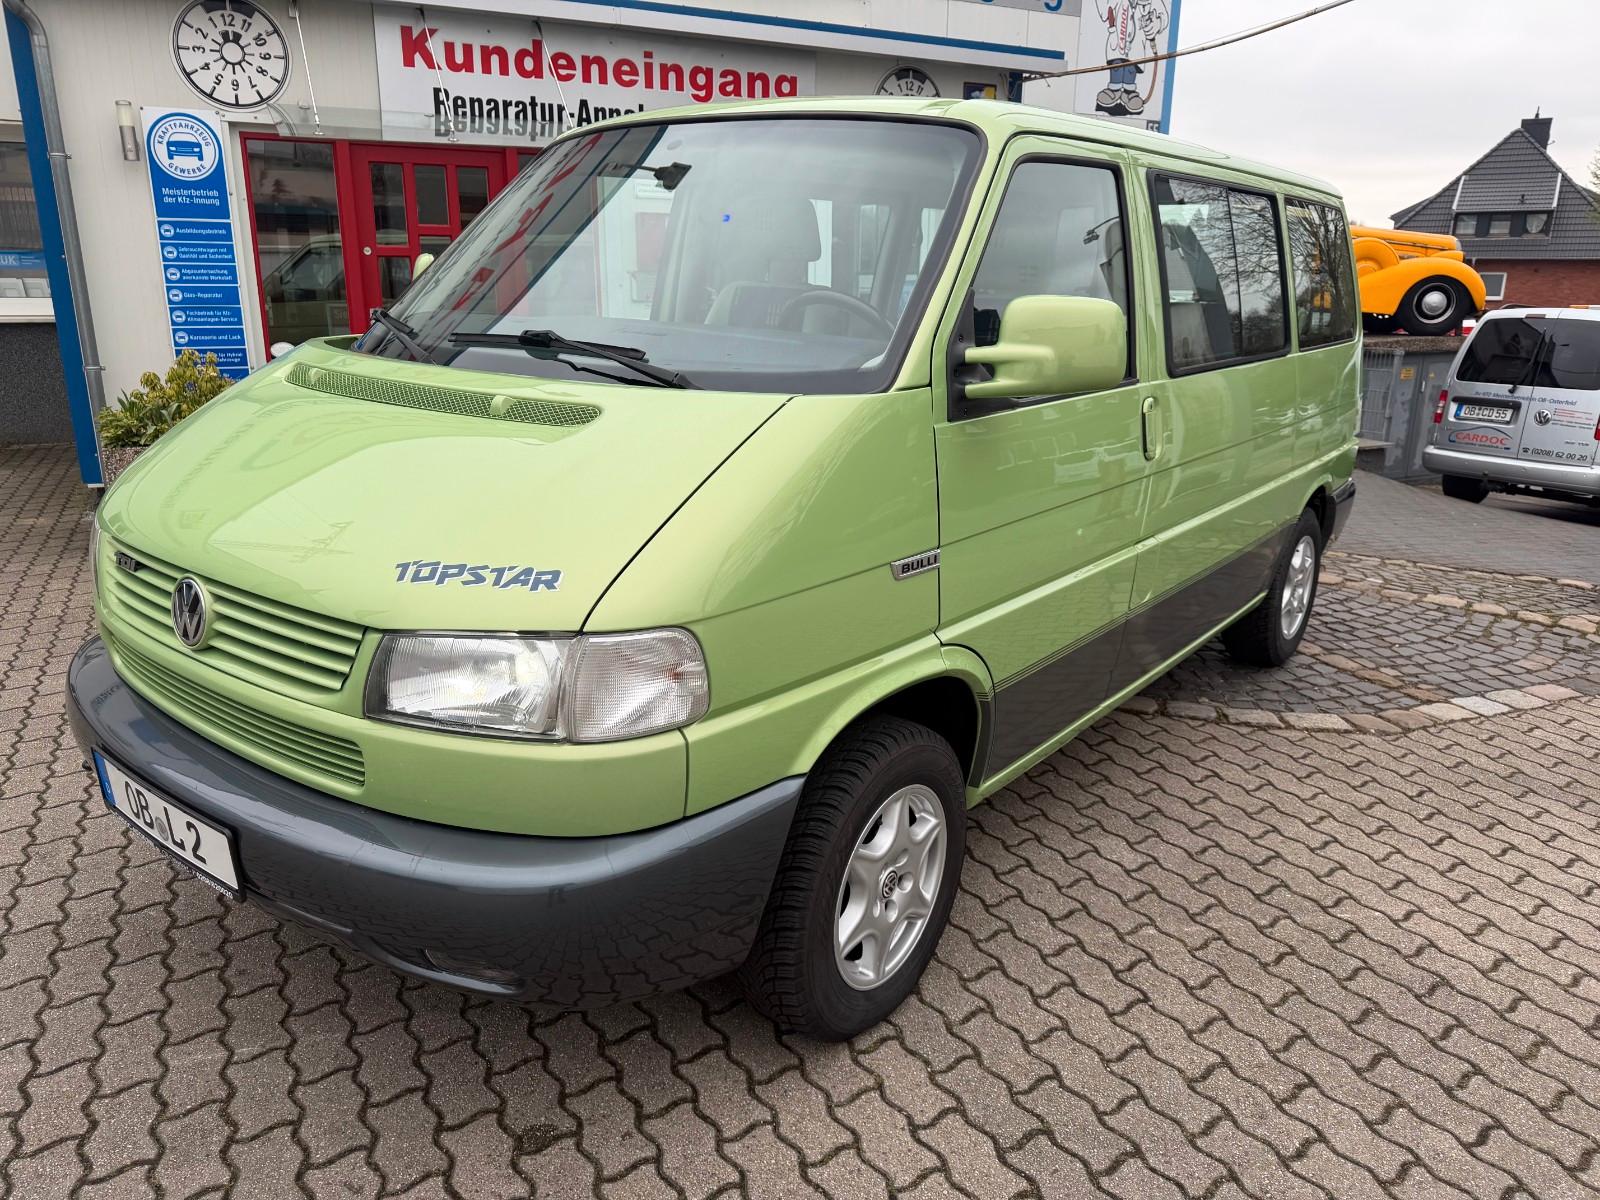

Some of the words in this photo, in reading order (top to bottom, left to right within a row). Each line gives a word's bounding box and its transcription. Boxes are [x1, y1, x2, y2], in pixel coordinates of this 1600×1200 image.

[208, 16, 217, 28] 1
[220, 13, 236, 27] 12
[240, 19, 252, 32] 11
[194, 27, 208, 39] 2
[253, 32, 267, 47] 10
[192, 45, 205, 54] 3
[199, 62, 211, 72] 4
[400, 25, 798, 103] Kundeneingang
[256, 65, 269, 77] 8
[213, 73, 224, 86] 5
[905, 81, 914, 91] 12
[157, 121, 212, 147] KRAFTFAHRZEUG
[168, 162, 207, 175] GEWERBE
[161, 187, 219, 197] Meisterbetrieb
[177, 196, 220, 206] Kfz-Innung
[1464, 406, 1476, 416] OB
[1481, 407, 1495, 418] CD
[1494, 409, 1508, 419] 55
[1455, 431, 1509, 445] CARDOC
[1531, 447, 1554, 457] (0208)
[1566, 452, 1576, 460] 00
[901, 554, 937, 574] BULLI
[395, 559, 563, 592] TOPSTAR
[124, 780, 154, 830] OB
